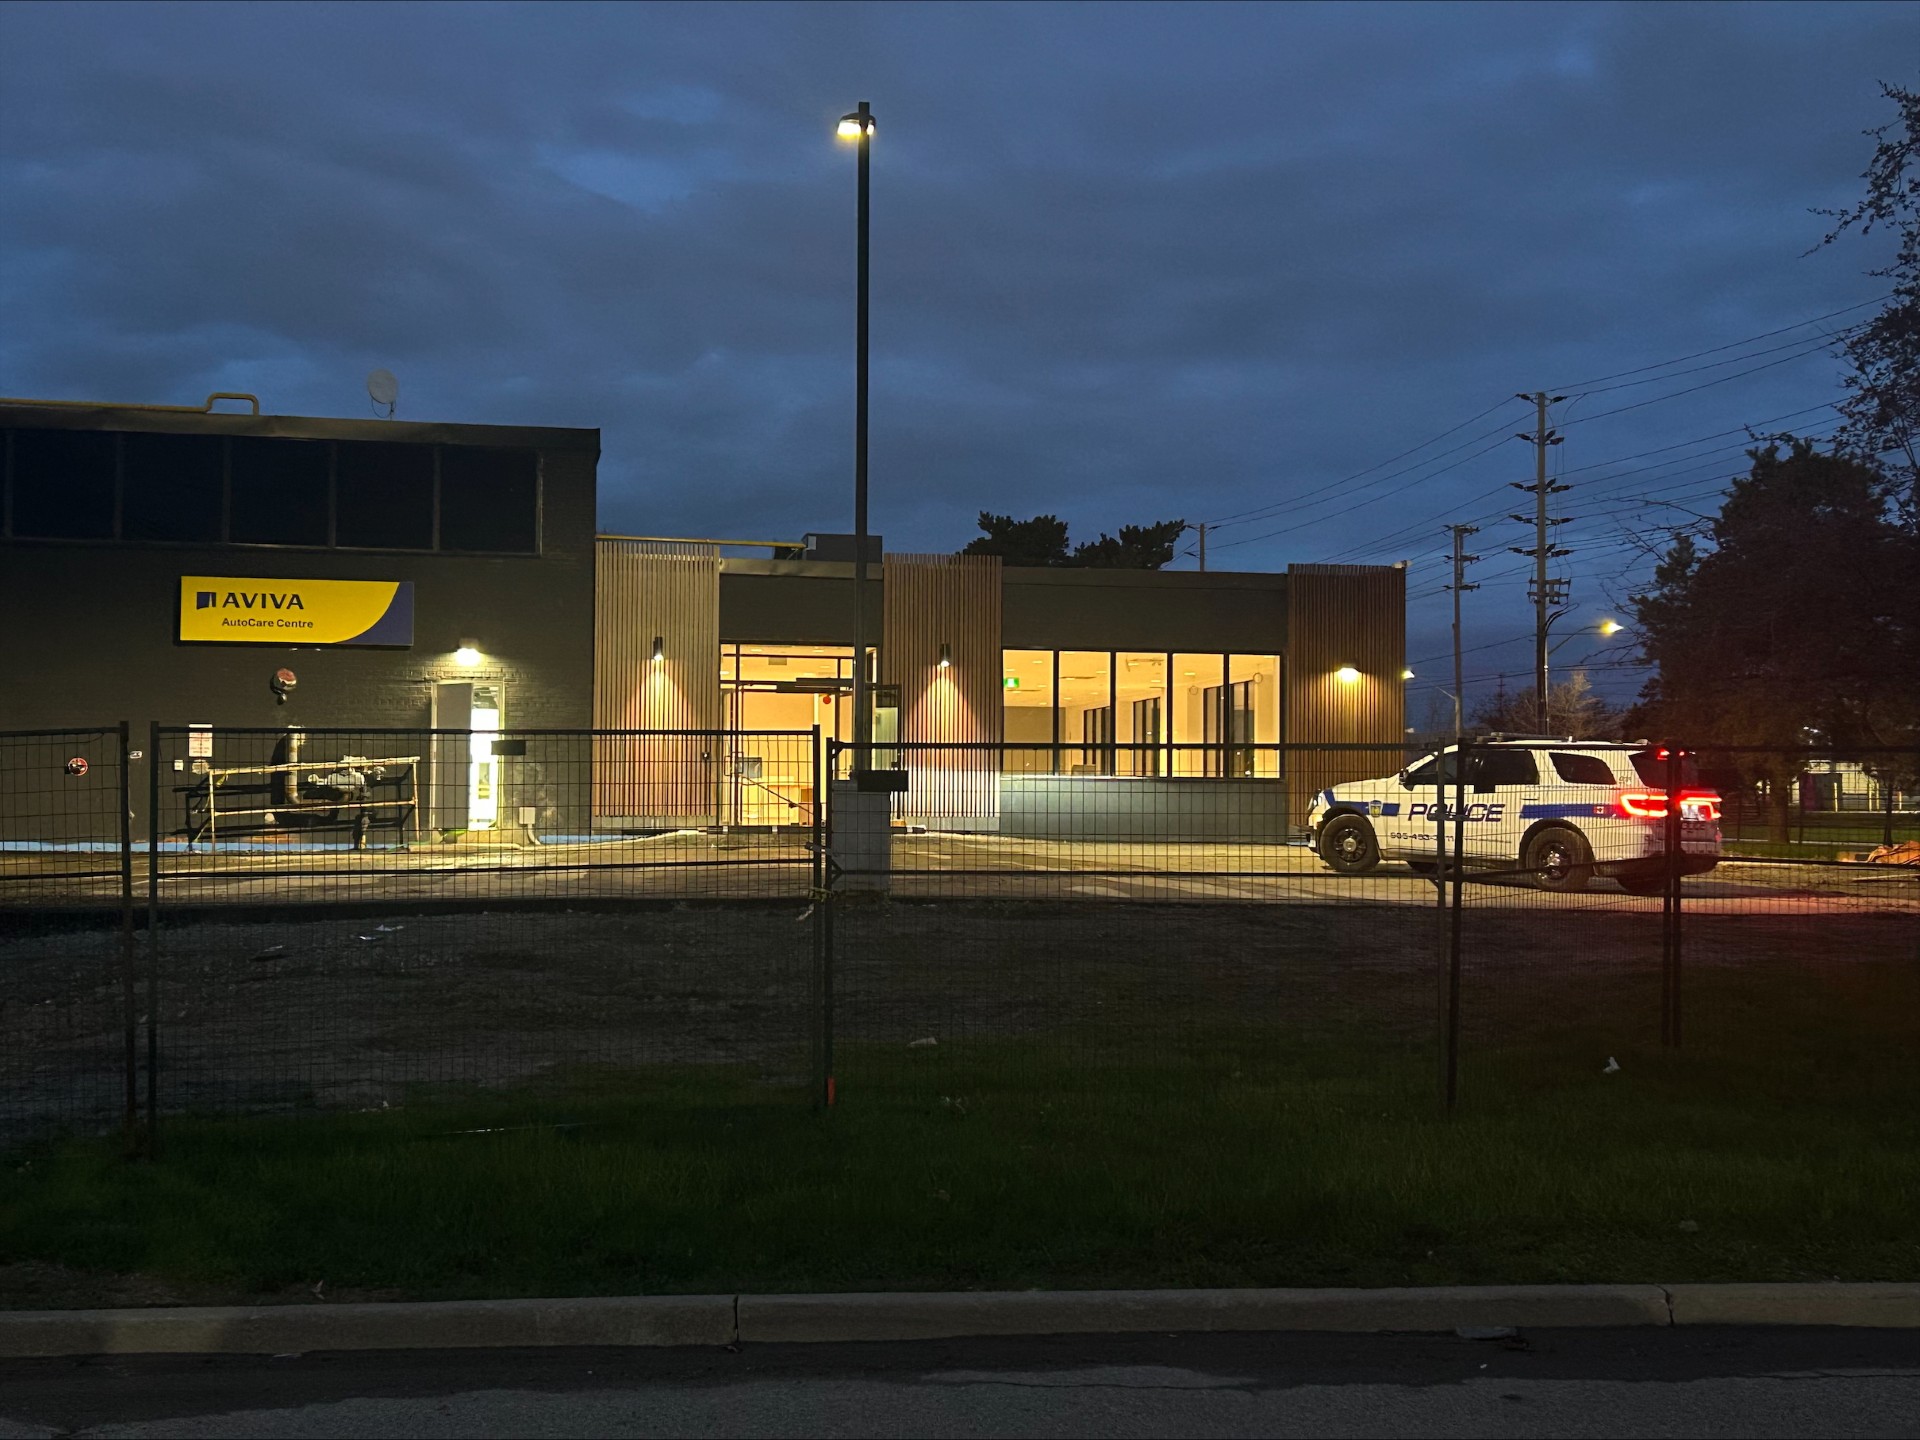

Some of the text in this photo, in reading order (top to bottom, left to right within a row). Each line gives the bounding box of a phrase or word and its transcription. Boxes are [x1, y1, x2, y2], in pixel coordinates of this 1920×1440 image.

[222, 592, 304, 610] AVIVA
[222, 618, 314, 628] AutoCare Centre
